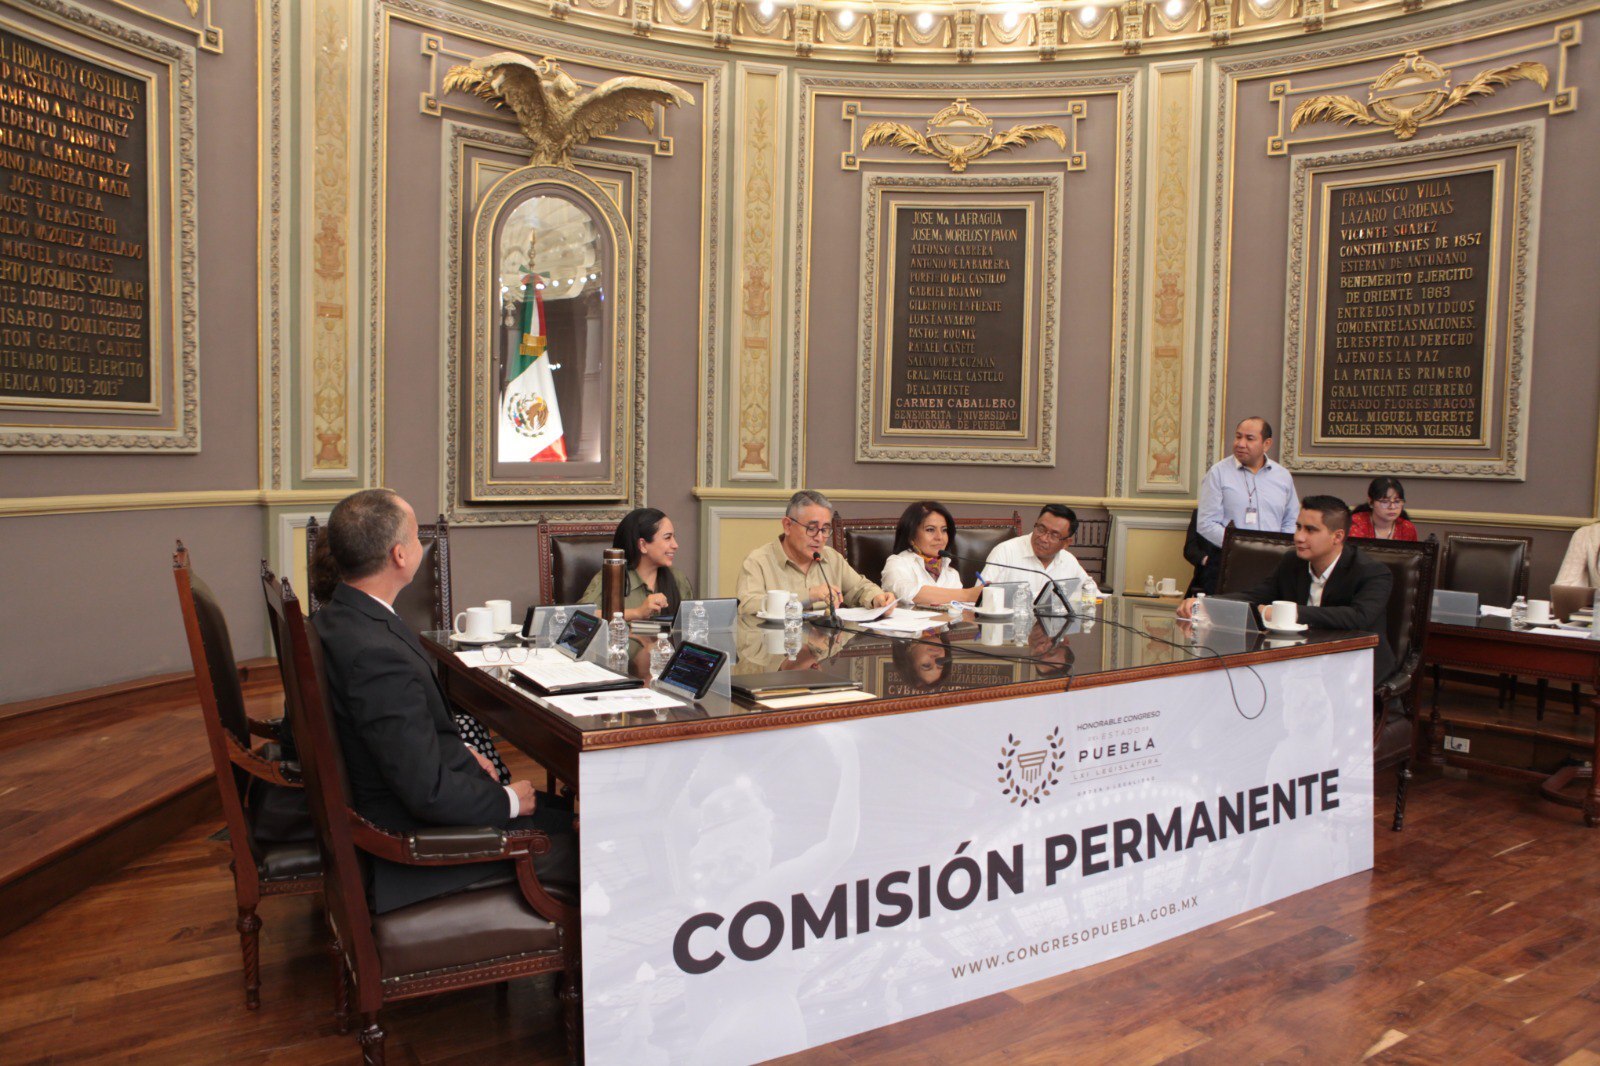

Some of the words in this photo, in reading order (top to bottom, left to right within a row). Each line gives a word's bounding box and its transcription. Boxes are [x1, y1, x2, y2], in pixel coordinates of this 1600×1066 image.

[0, 38, 9, 59] L
[12, 42, 68, 79] HIDALGO
[69, 65, 77, 83] Y
[80, 68, 140, 103] COSTILLA
[14, 66, 78, 100] PASTRANA
[82, 92, 134, 120] JAIMES
[66, 106, 128, 137] MARTINEZ
[54, 143, 130, 177] MANJARREZ
[29, 159, 84, 186] BANDERA
[87, 172, 95, 188] Y
[99, 176, 130, 197] MATA
[9, 175, 42, 197] JOSE
[51, 185, 103, 211] RIVERA
[1343, 188, 1407, 207] FRANCISCO
[1417, 182, 1451, 198] VILLA
[36, 204, 116, 234] VERASTEGUI
[912, 212, 933, 224] JOSE
[955, 213, 1001, 225] LAFRAGUA
[1341, 208, 1386, 225] LAZARO
[1393, 200, 1454, 220] CARDENAS
[911, 229, 931, 241] JOSE
[945, 230, 982, 241] MORELOS
[982, 230, 989, 241] Y
[992, 230, 1017, 241] PAVON
[1341, 226, 1387, 240] VICENTE
[1394, 221, 1437, 236] SUAREZ
[90, 235, 142, 259] MELLADO
[911, 245, 950, 254] ALFONSO
[955, 245, 993, 255] CABRERA
[1340, 238, 1429, 257] CONSTITUYENTES
[1436, 236, 1448, 248] DE
[1454, 233, 1482, 247] 1857
[2, 241, 53, 264] MIGUEL
[58, 251, 113, 273] ROSALES
[911, 259, 946, 268] ANTONIO
[949, 259, 957, 268] DE
[960, 259, 970, 269] LA
[972, 260, 1009, 269] BARRERA
[1340, 260, 1384, 272] ESTEBAN
[1391, 257, 1402, 268] DE
[31, 267, 85, 291] BOSQUES
[952, 274, 966, 283] DEL
[969, 274, 1006, 284] CASTILLO
[1340, 273, 1411, 288] BENEMERITO
[1417, 268, 1473, 283] EJERCITO
[910, 287, 945, 296] GABRIEL
[949, 287, 982, 297] ROJANO
[1346, 292, 1359, 303] DE
[1364, 289, 1412, 302] ORIENTE
[1422, 286, 1450, 299] 1863
[0, 287, 17, 302] TE
[22, 289, 84, 312] LOMBARDO
[91, 300, 142, 319] TOLEDANO
[910, 301, 946, 310] GILBERTO
[972, 302, 1001, 311] FUENTE
[1338, 307, 1372, 318] ENTRE
[1376, 306, 1394, 317] LOS
[1398, 301, 1475, 315] INDIVIDUOS
[61, 316, 141, 338] DOMINGUEZ
[909, 315, 928, 324] LUIS
[938, 315, 975, 325] NAVARRO
[1337, 323, 1362, 333] COMO
[1365, 321, 1396, 332] ENTRE
[1399, 320, 1417, 331] LAS
[0, 330, 30, 346] TON
[38, 333, 90, 352] GARCIA
[909, 329, 938, 338] PASTOR
[1337, 338, 1350, 348] EL
[1351, 335, 1399, 347] RESPETO
[1403, 335, 1417, 346] AL
[1421, 333, 1473, 346] DERECHO
[909, 342, 939, 352] RAFAEL
[0, 351, 57, 371] TENARIO
[63, 357, 84, 373] DEL
[89, 359, 143, 377] EJERCITO
[908, 357, 949, 366] SALVADOR
[1337, 352, 1374, 363] AJENO
[1379, 352, 1391, 362] ES
[1397, 351, 1410, 362] LA
[1417, 351, 1439, 362] PAZ
[933, 371, 962, 380] MIGUEL
[966, 372, 1003, 381] CASTULO
[1334, 369, 1348, 380] LA
[1354, 369, 1392, 380] PATRIA
[1398, 368, 1410, 379] ES
[1418, 367, 1470, 378] PRIMERO
[0, 373, 56, 393] EXICANO
[907, 385, 917, 394] DE
[920, 385, 969, 395] ALATRISTE
[1362, 385, 1407, 397] VICENTE
[1413, 384, 1472, 396] GUERRERO
[896, 398, 943, 407] CARMEN
[948, 399, 1016, 408] CABALLERO
[1330, 400, 1379, 409] RICARDO
[1385, 399, 1429, 409] FLORES
[1434, 398, 1475, 408] MAGON
[895, 411, 951, 419] BENEMERITA
[958, 411, 1017, 420] UNIVERSIDAD
[1367, 412, 1412, 421] MIGUEL
[1416, 411, 1474, 421] NEGRETE
[902, 420, 951, 429] AUTONOMA
[958, 421, 969, 429] DE
[972, 421, 1006, 429] PUEBLA
[1328, 426, 1371, 435] ANGELES
[1375, 425, 1417, 436] ESPINOSA
[1424, 425, 1471, 436] YGLESIAS
[1077, 718, 1121, 731] HONORABLE
[1123, 711, 1160, 722] CONGRESO
[1079, 738, 1155, 762] PUEBLA
[1096, 758, 1159, 775] LEGISLATURA
[672, 841, 1024, 974] COMISIÓN
[1046, 768, 1340, 886] PERMANENTE
[951, 896, 1200, 979] WWW.CONGRESOPUEBLA.GOB.MX
